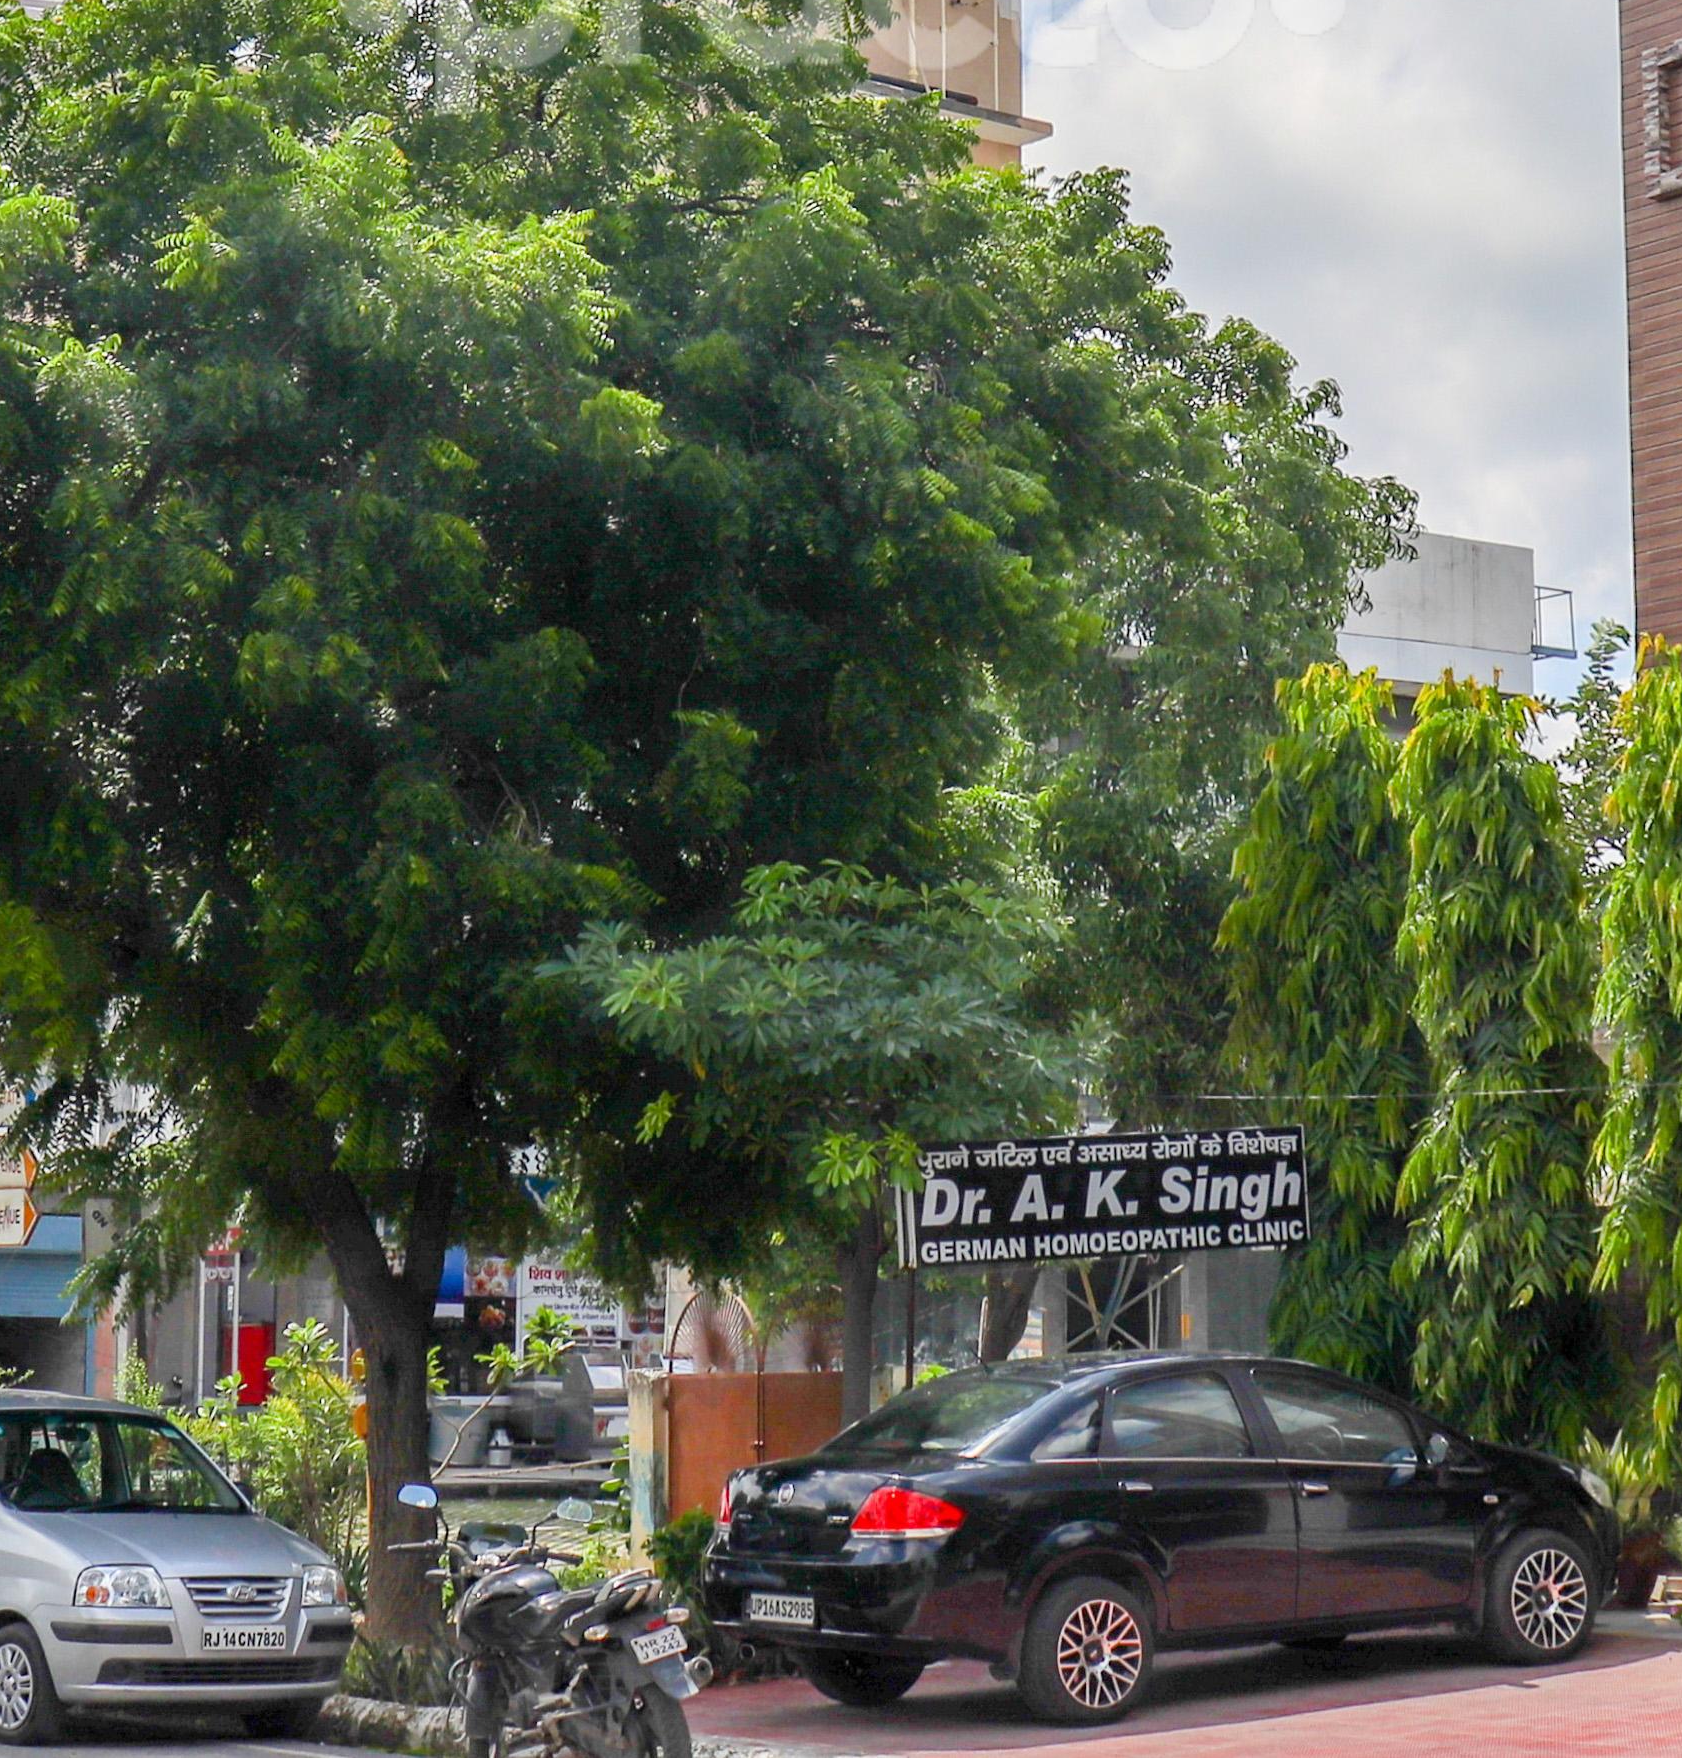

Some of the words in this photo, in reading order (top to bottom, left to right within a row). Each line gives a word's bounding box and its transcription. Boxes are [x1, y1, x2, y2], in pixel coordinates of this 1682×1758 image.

[974, 1141, 1038, 1168] जटिल
[1041, 1139, 1074, 1166] एवं
[1077, 1142, 1148, 1164] असाध्य
[1152, 1134, 1198, 1160] रोगों
[1200, 1132, 1223, 1156] के
[1227, 1130, 1299, 1156] विशेषज्ञ
[921, 1178, 992, 1227] Dr.
[1010, 1174, 1065, 1222] A.
[1085, 1169, 1139, 1218] K.
[1159, 1161, 1302, 1221] Singh
[921, 1237, 1027, 1264] GERMAN
[1033, 1227, 1221, 1258] HOMOEOPATHIC
[1228, 1219, 1304, 1247] CLINIC
[639, 1639, 659, 1651] HR
[661, 1632, 676, 1644] 22
